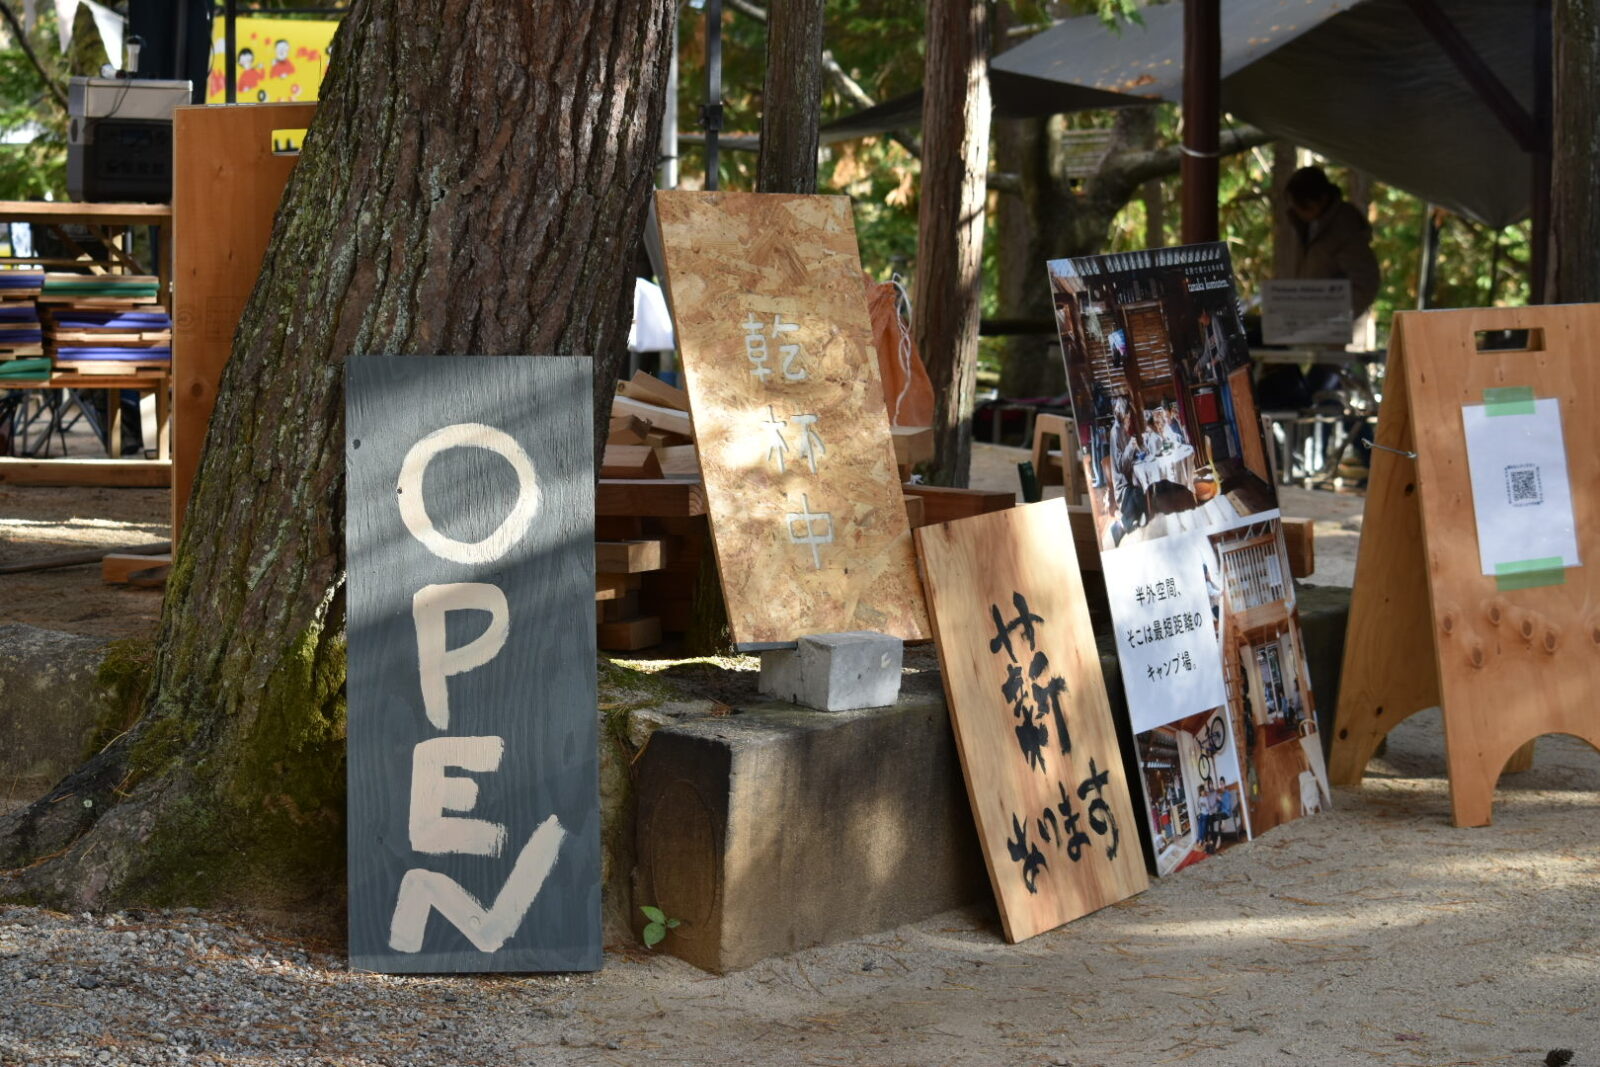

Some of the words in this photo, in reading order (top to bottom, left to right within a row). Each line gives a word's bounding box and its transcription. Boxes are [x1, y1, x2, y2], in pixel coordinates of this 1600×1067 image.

[742, 312, 835, 568] 乾杯中
[1127, 611, 1203, 649] そこは最短距離の
[1135, 577, 1182, 606] 半外空間、
[389, 423, 566, 952] OPEN
[990, 591, 1071, 774] 薪
[1008, 756, 1119, 894] あります
